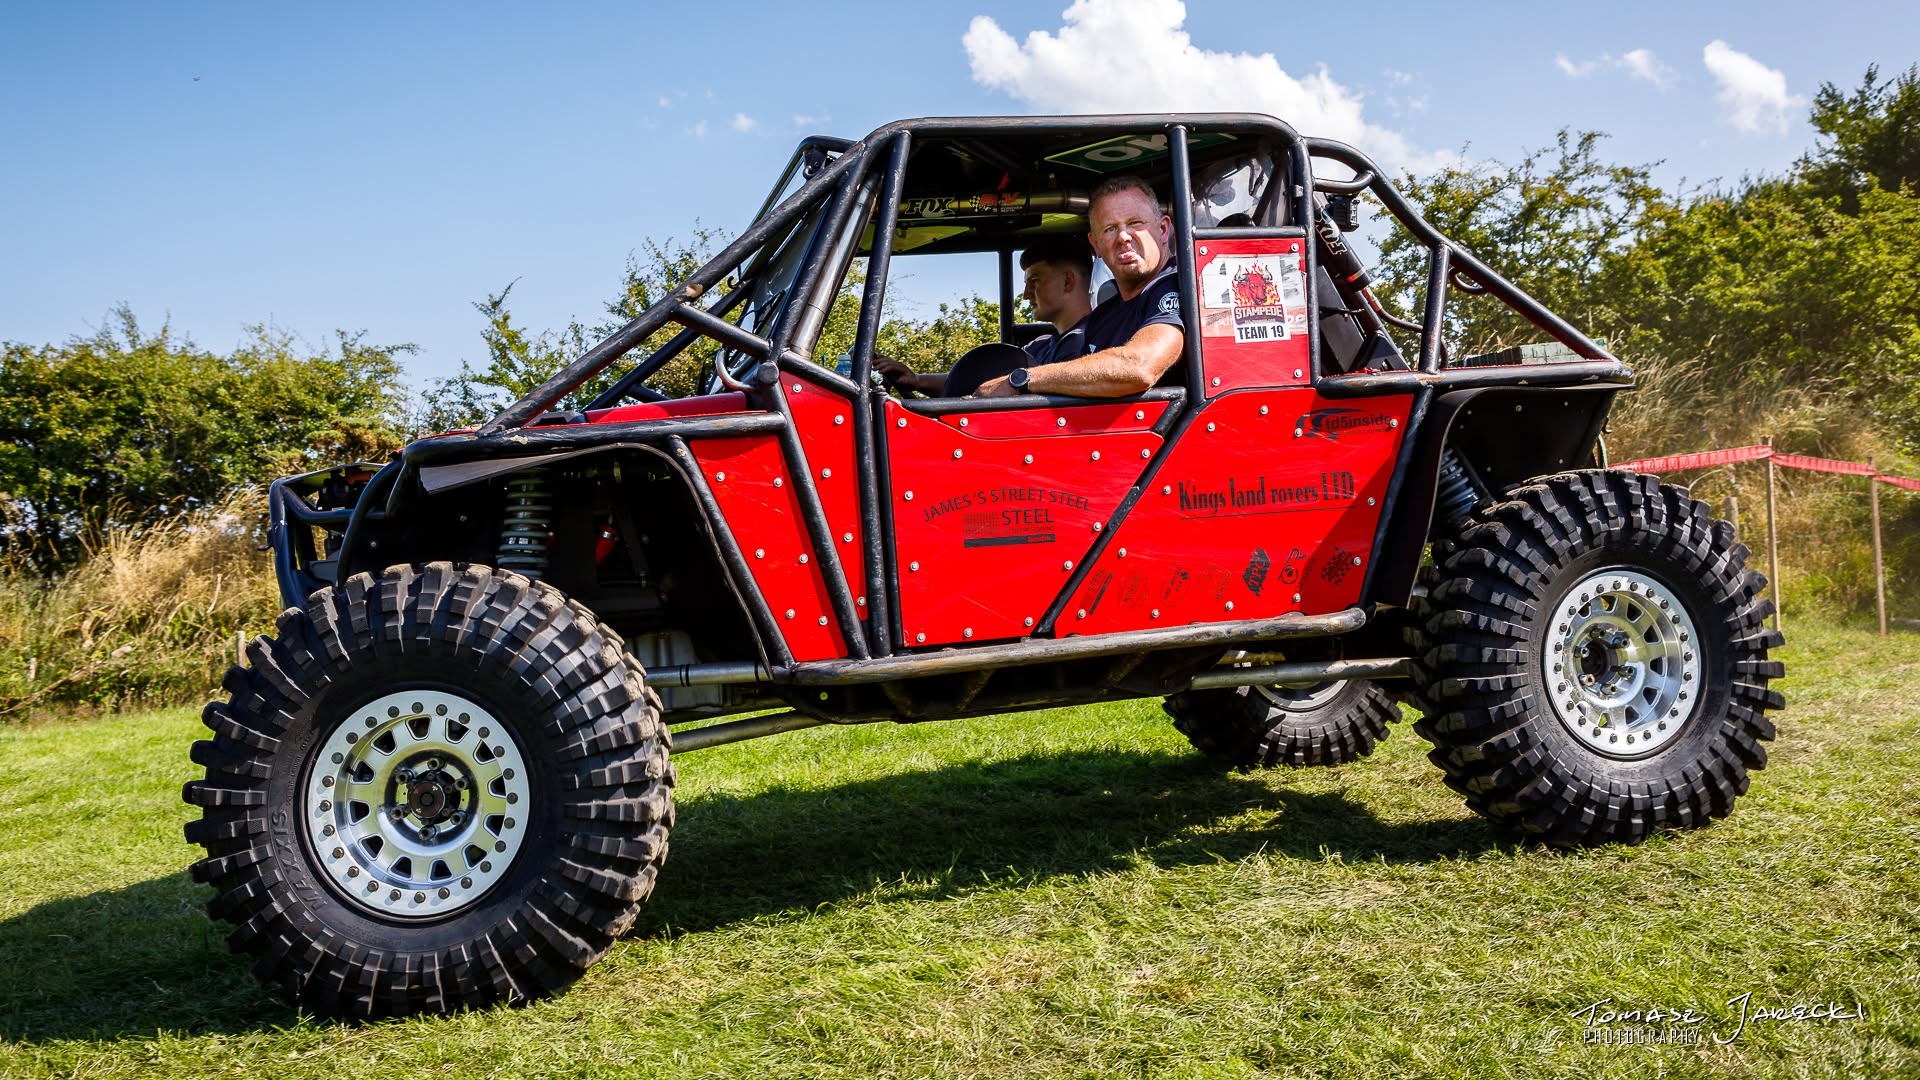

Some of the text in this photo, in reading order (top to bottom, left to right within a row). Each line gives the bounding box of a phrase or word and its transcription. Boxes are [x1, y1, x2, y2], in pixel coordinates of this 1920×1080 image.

[904, 197, 956, 217] FOX
[1315, 210, 1348, 255] FOX
[1235, 305, 1284, 320] STAMPEDE
[1237, 325, 1285, 340] TEAM 19
[989, 487, 1045, 503] STREET
[1048, 490, 1091, 511] STEEL
[1178, 471, 1355, 514] Kings land rovers LTD
[1001, 508, 1055, 526] STEEL
